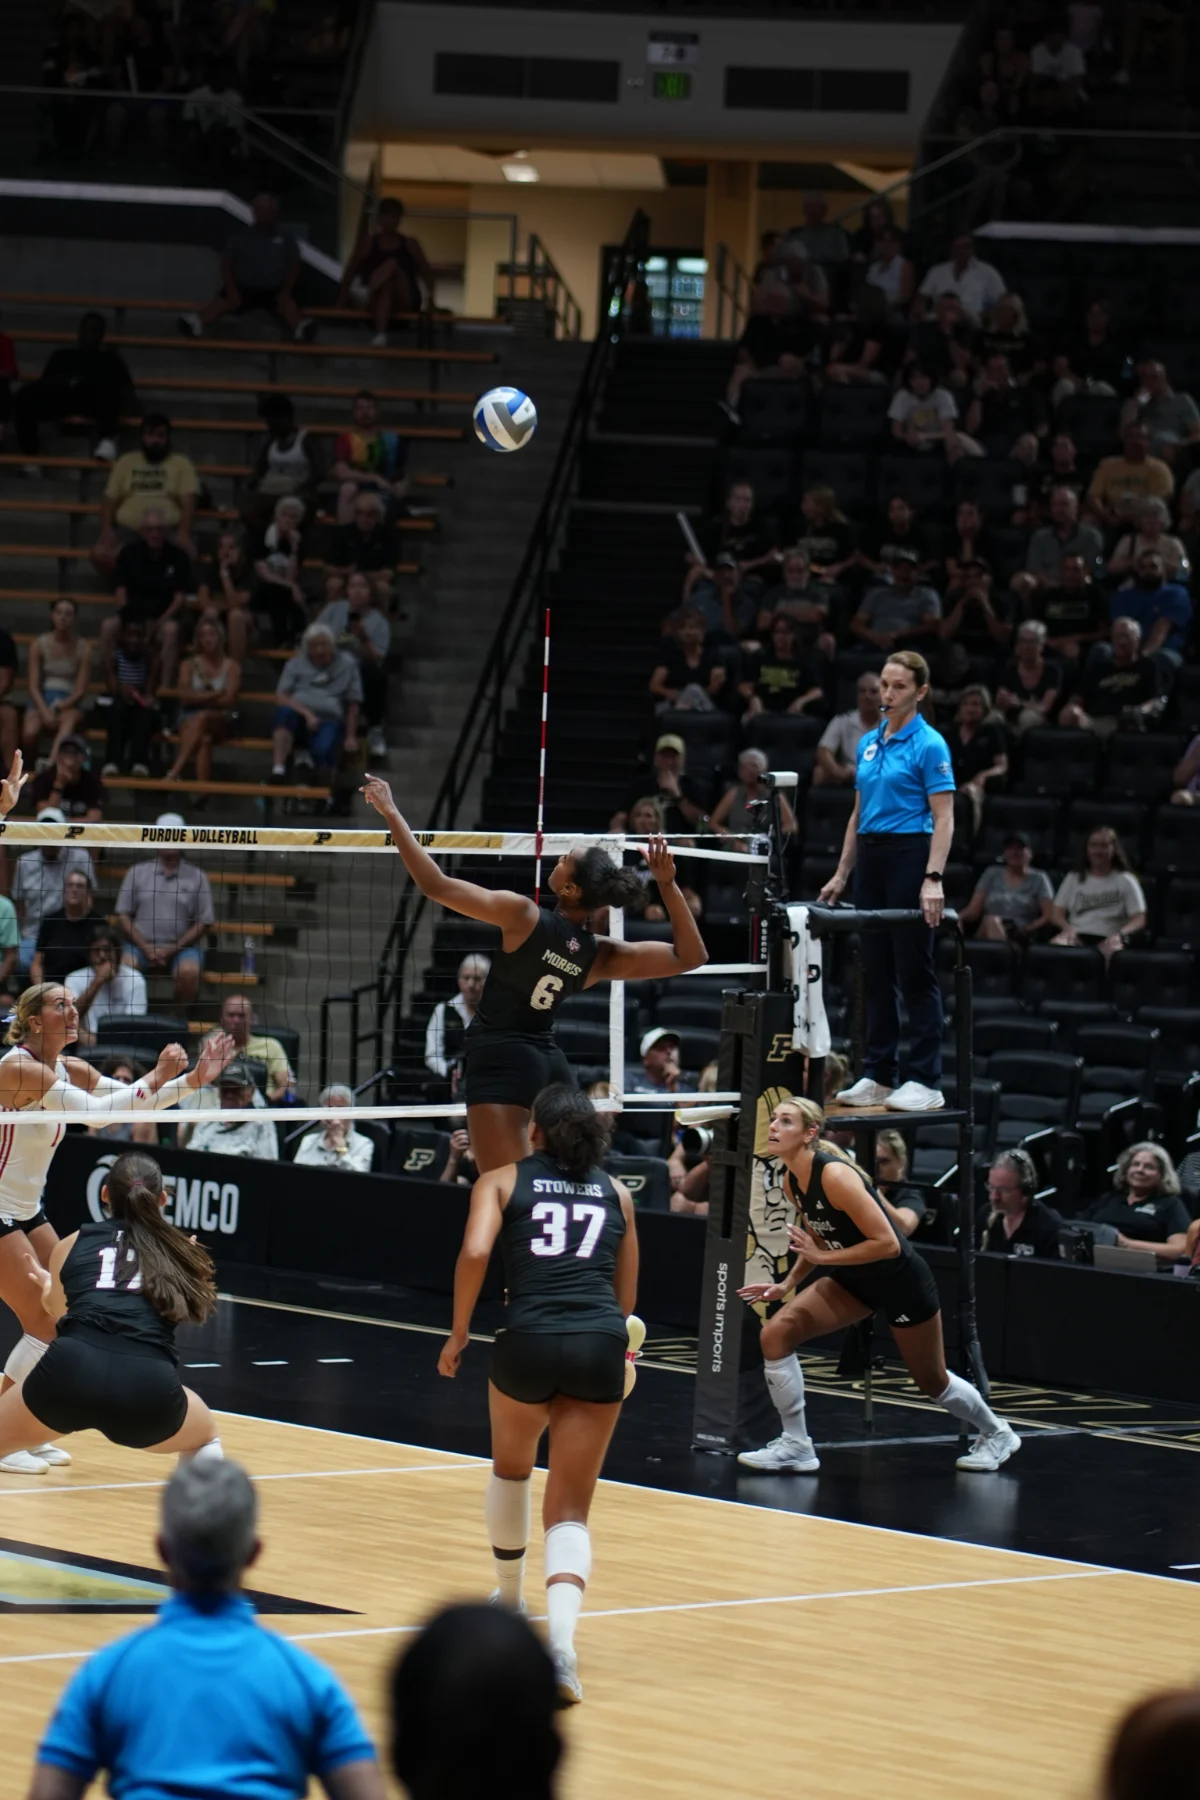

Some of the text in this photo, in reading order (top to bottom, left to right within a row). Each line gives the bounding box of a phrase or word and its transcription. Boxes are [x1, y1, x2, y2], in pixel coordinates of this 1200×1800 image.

[141, 828, 258, 844] PURDUE VOLLEYBALL
[421, 834, 434, 846] UP
[541, 949, 582, 976] MORRIS
[530, 974, 564, 1010] 6
[402, 1148, 435, 1171] P
[532, 1179, 604, 1198] STOWERS
[530, 1202, 606, 1258] 37
[711, 1262, 728, 1373] sports imports
